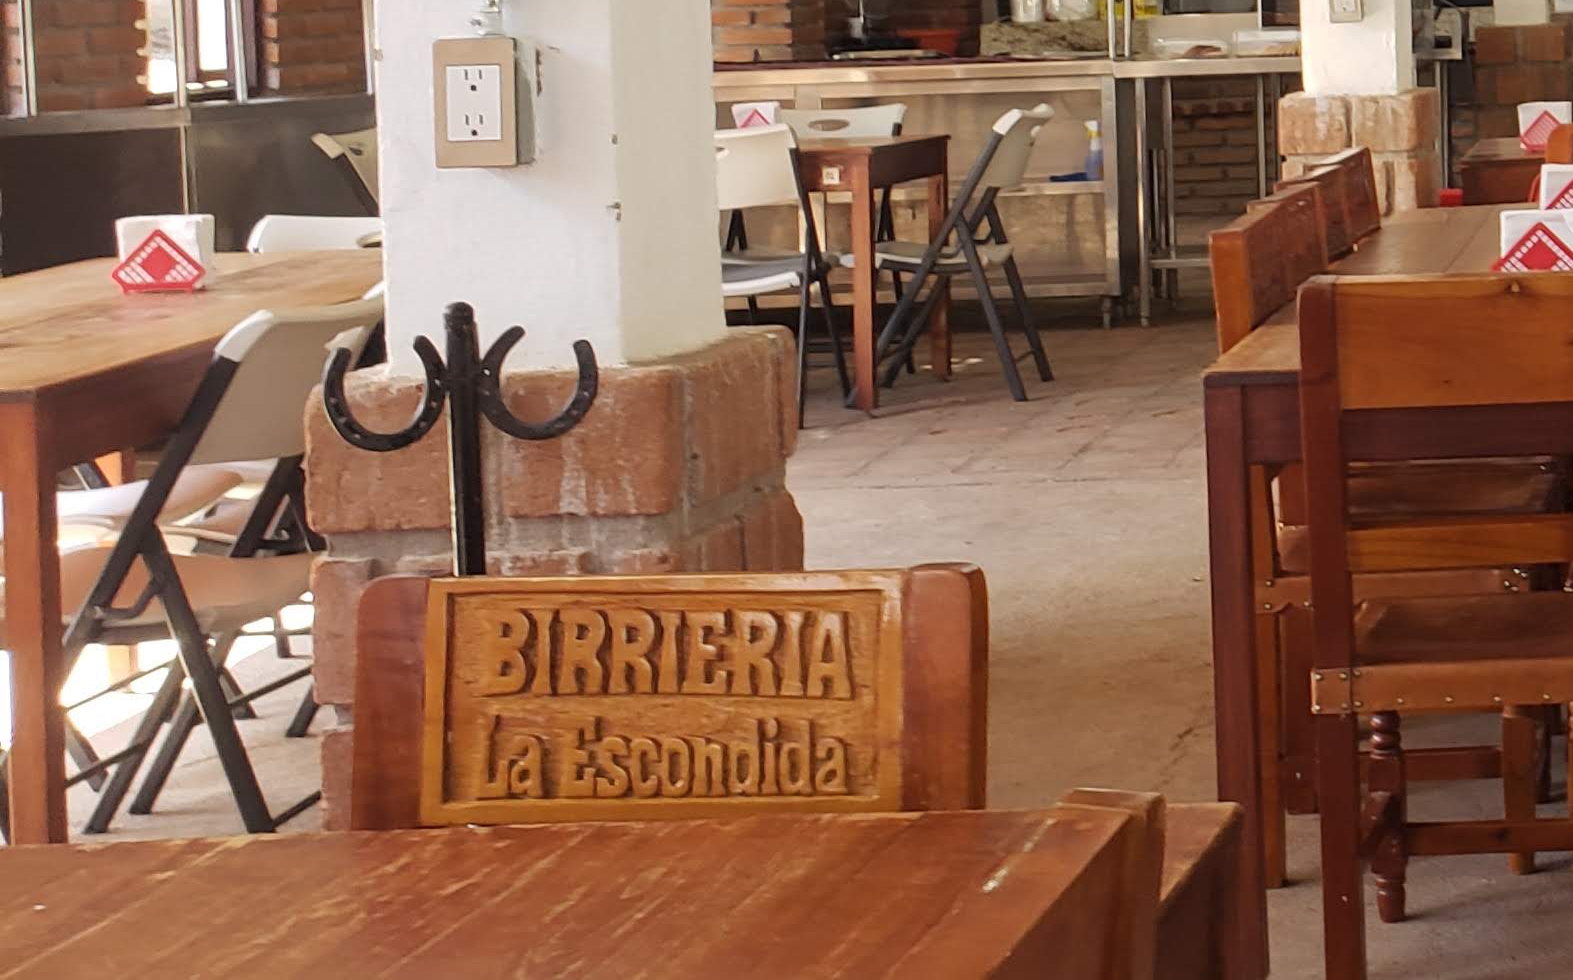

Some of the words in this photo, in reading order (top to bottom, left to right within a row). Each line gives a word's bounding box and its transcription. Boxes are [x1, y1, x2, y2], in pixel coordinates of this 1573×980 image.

[482, 608, 855, 700] BIRRIERIA
[478, 712, 541, 800] La
[556, 715, 849, 800] Escondida
